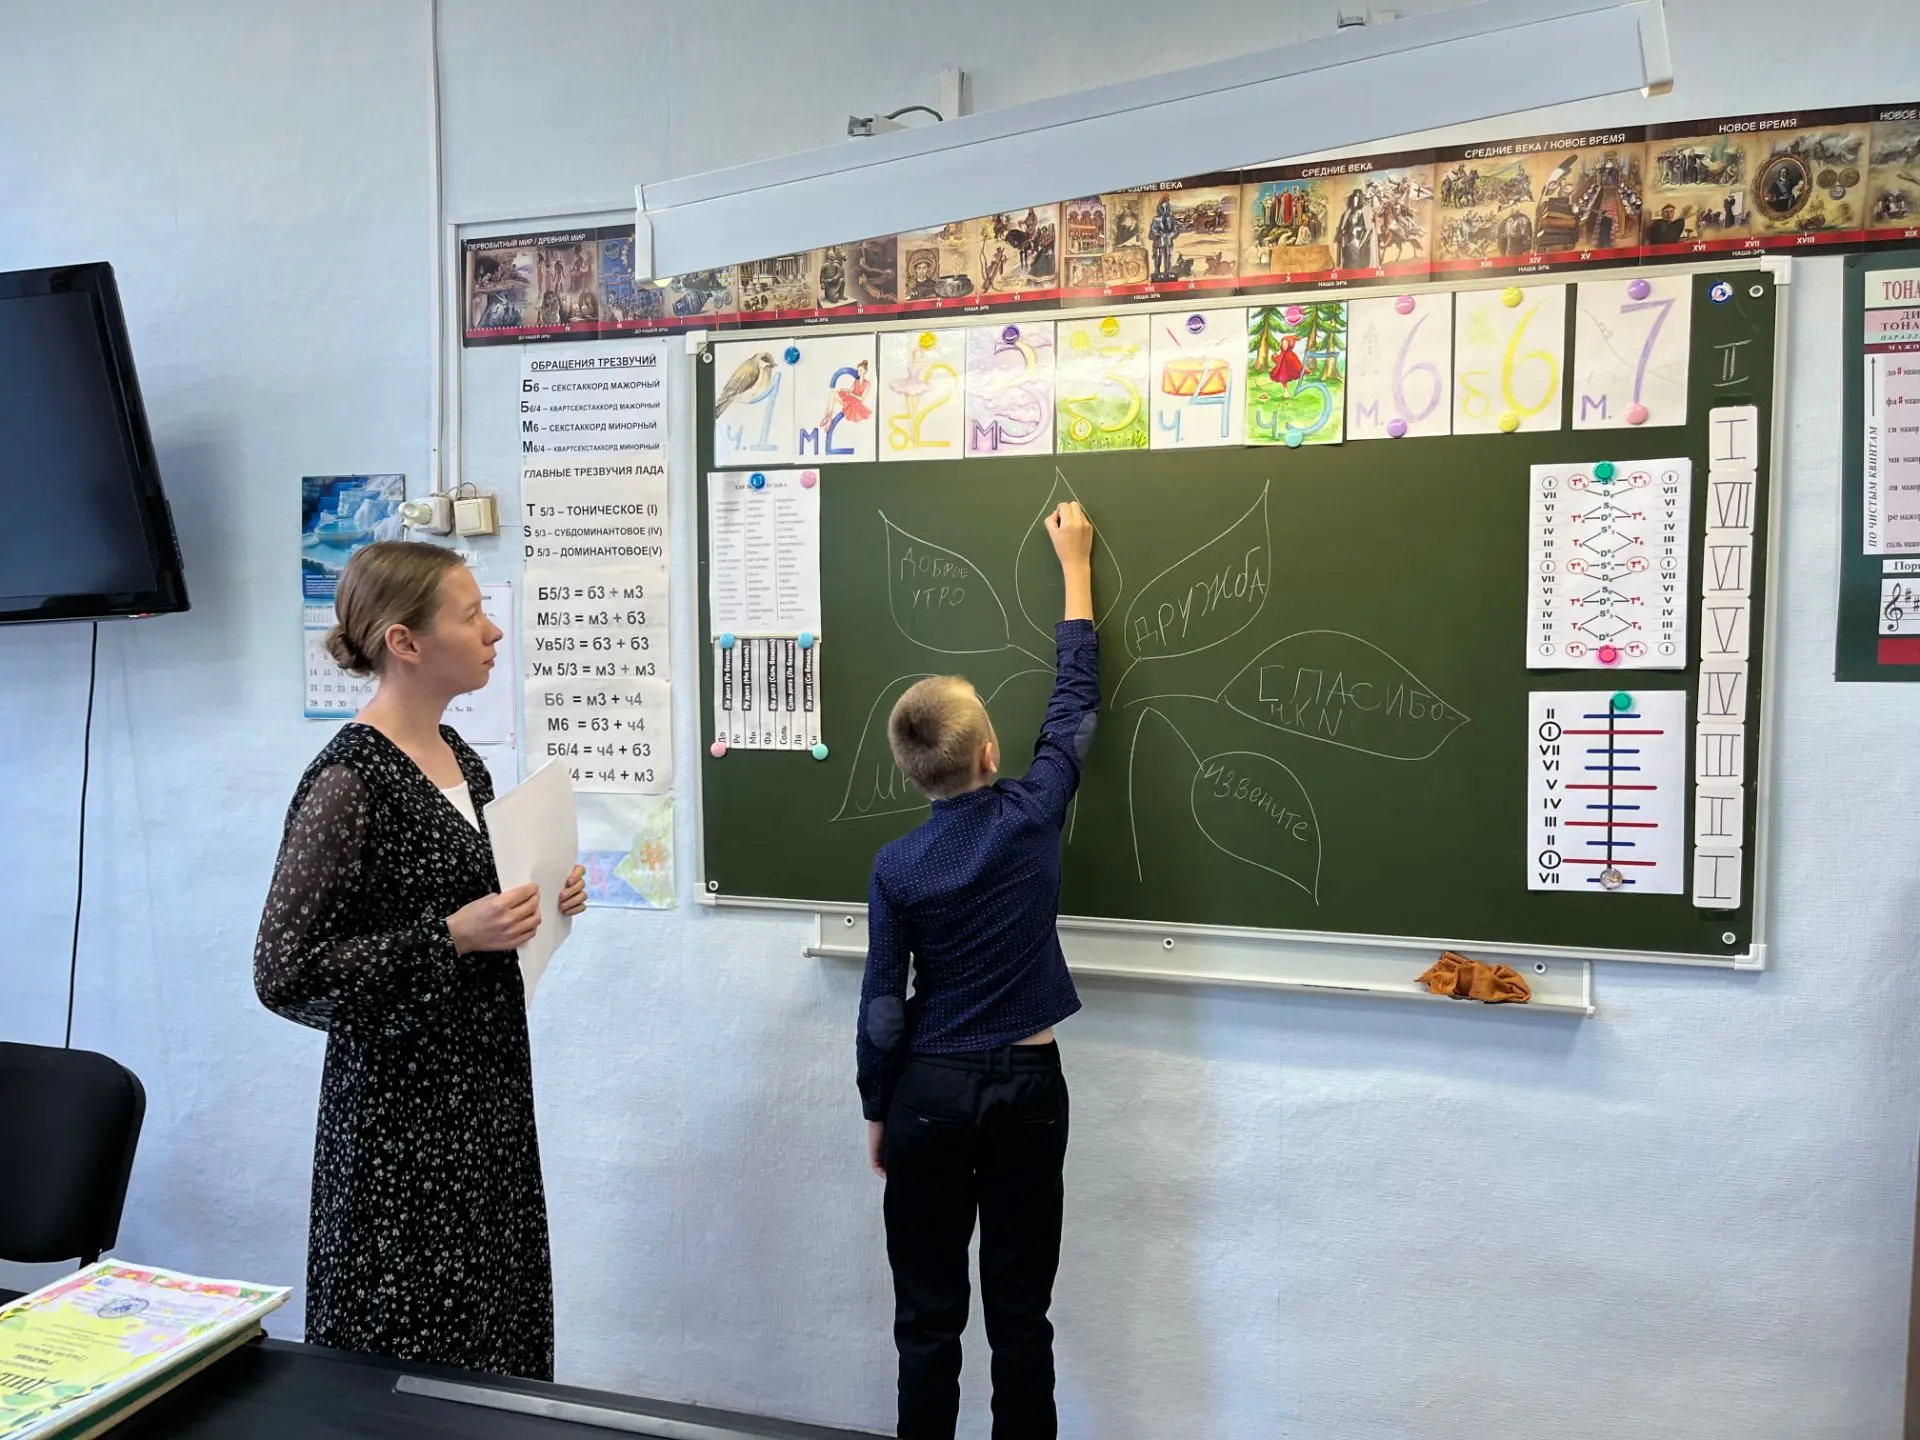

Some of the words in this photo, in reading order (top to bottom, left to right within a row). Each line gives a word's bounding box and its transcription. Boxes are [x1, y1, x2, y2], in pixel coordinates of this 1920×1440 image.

[1880, 111, 1916, 121] НОВОЕ
[1719, 122, 1756, 134] НОВОЕ
[1759, 118, 1797, 130] ВРЕМЯ
[1465, 145, 1513, 159] СРЕДНИЕ
[1515, 142, 1541, 153] ВЕКА
[1550, 137, 1586, 150] НОВОЕ
[1589, 133, 1625, 144] ВРЕМЯ
[1302, 165, 1346, 177] СРЕДНИЕ
[1348, 162, 1372, 172] ВЕКА
[1160, 181, 1182, 190] ВЕКА
[468, 240, 518, 250] ПЕРВОБЫТНЫЙ
[518, 239, 533, 247] МИР
[538, 236, 570, 245] ДРЕВНИЙ
[570, 233, 586, 241] МИР
[1744, 240, 1760, 248] XVII
[1797, 236, 1815, 244] XVIII
[531, 359, 595, 370] ОБРАЩЕНИЯ
[599, 354, 656, 367] ТРЕЗВУЧИЙ
[523, 379, 540, 392] Б6
[551, 382, 608, 391] СЕКСТАККОРД
[610, 379, 660, 390] МАЖОРНЫЙ
[521, 401, 541, 413] Б6/4
[550, 404, 618, 412] КВАРТСЕКСТАККОРД
[619, 402, 660, 410] МАЖОРНЫЙ
[522, 421, 539, 433] М6
[550, 423, 606, 432] СЕКСТАККОРД
[608, 420, 657, 430] МИНОРНЫЙ
[522, 441, 545, 453] М6/4
[554, 444, 618, 452] КВАРТСЕКСТАККОРД
[619, 443, 660, 451] МИНОРНЫЙ
[524, 468, 571, 479] ГЛАВНЫЕ
[574, 466, 632, 477] ТРЕЗВУЧИЯ
[635, 465, 664, 475] ЛАДА
[540, 507, 554, 517] 5/3
[567, 504, 643, 516] ТОНИЧЕСКОЕ
[647, 504, 658, 516] (I)
[1710, 482, 1753, 528] VII
[1868, 482, 1877, 528] ЧИСТЫМ
[524, 525, 531, 537] S
[535, 529, 546, 537] 5/3
[554, 527, 645, 537] СУБДОМИНАНТОВОЕ
[648, 527, 662, 536] (IV)
[1664, 523, 1675, 531] IV
[1868, 532, 1876, 547] ПО
[525, 546, 534, 557] D
[537, 548, 550, 557] 5/3
[1708, 545, 1748, 591] VI
[1542, 575, 1555, 583] VII
[538, 587, 570, 600] Б5/3
[588, 585, 605, 600] б3
[623, 585, 643, 599] м3
[912, 586, 965, 609] УТРО
[537, 612, 571, 626] М5/3
[588, 612, 608, 625] м3
[627, 611, 646, 625] б3
[1707, 606, 1745, 654] V
[535, 638, 575, 651] Ув5/3
[593, 637, 611, 650] б3
[630, 637, 649, 650] б3
[1544, 634, 1551, 642] II
[533, 663, 552, 676] Ум
[557, 663, 578, 675] 5/3
[596, 663, 615, 675] м3
[635, 663, 655, 675] м3
[544, 693, 564, 706] Б6
[587, 693, 606, 706] м3
[625, 693, 642, 705] ч4
[1701, 672, 1743, 716] IV
[1547, 709, 1555, 719] II
[548, 718, 569, 731] М6
[591, 718, 609, 731] б3
[627, 718, 645, 731] ч4
[547, 743, 579, 756] Б6/4
[597, 743, 614, 756] ч4
[632, 743, 651, 756] б3
[1539, 744, 1560, 756] VII
[1700, 734, 1741, 777] III
[1543, 760, 1559, 771] VI
[599, 768, 615, 781] ч4
[634, 769, 654, 782] м3
[1546, 779, 1558, 790] V
[1544, 798, 1562, 809] IV
[1545, 816, 1557, 827] III
[1700, 795, 1735, 836] II
[1547, 835, 1555, 845] II
[1539, 873, 1559, 884] VII
[1697, 855, 1735, 900] I
